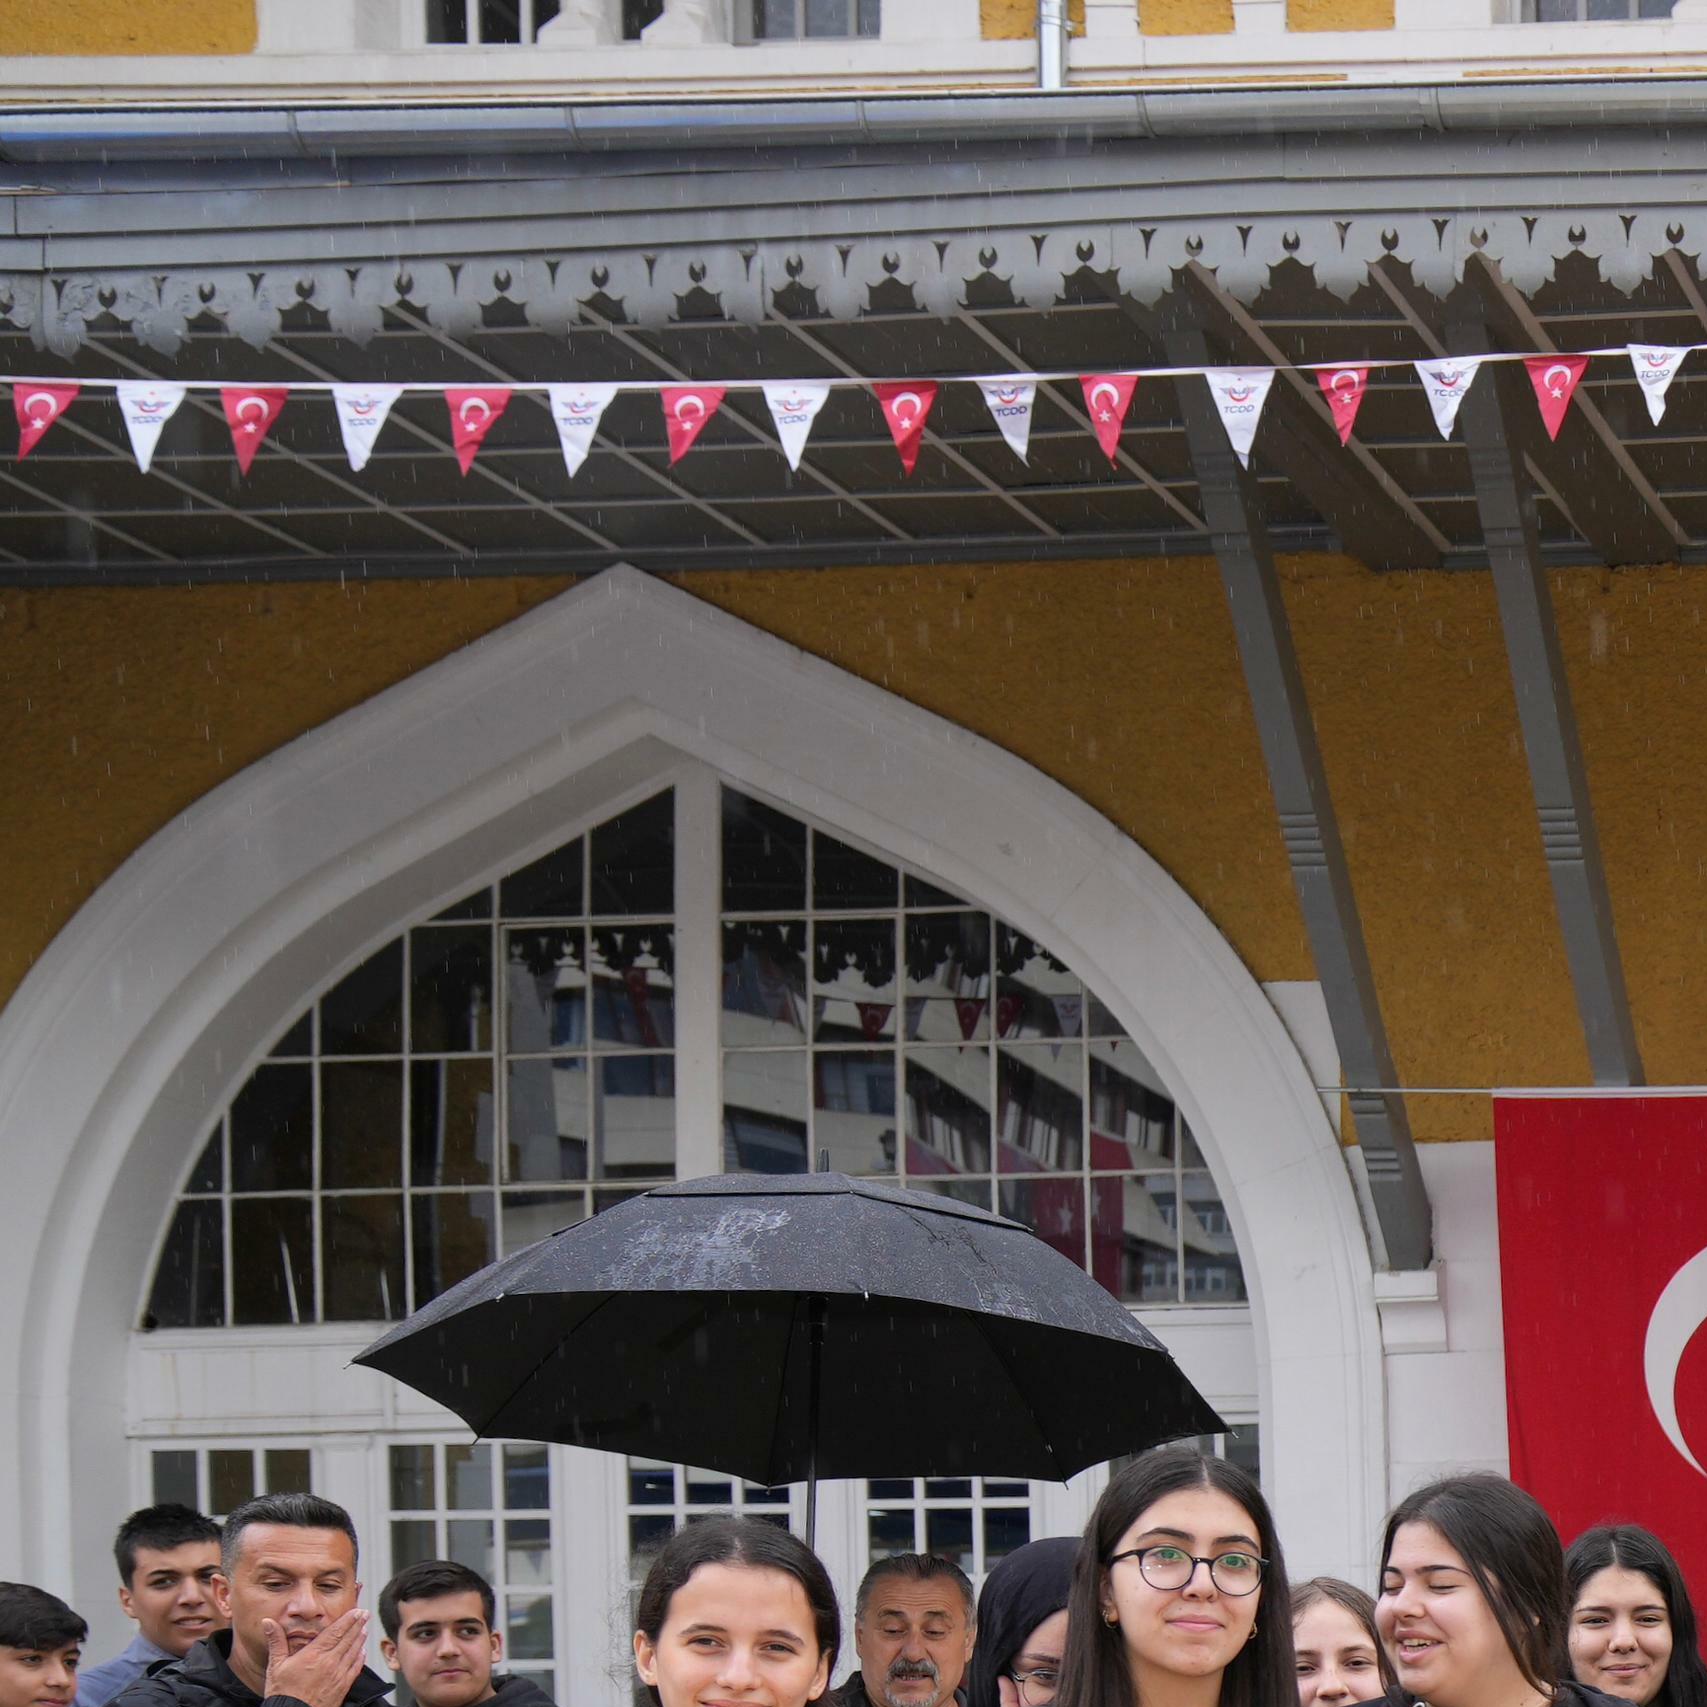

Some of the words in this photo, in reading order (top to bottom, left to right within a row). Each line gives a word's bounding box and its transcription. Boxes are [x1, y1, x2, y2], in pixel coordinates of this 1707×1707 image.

[1641, 370, 1670, 378] TCDD
[997, 406, 1027, 417] TCDD
[1224, 405, 1254, 413] TCDD
[563, 417, 593, 425] TCDD
[779, 414, 807, 424] TCDD
